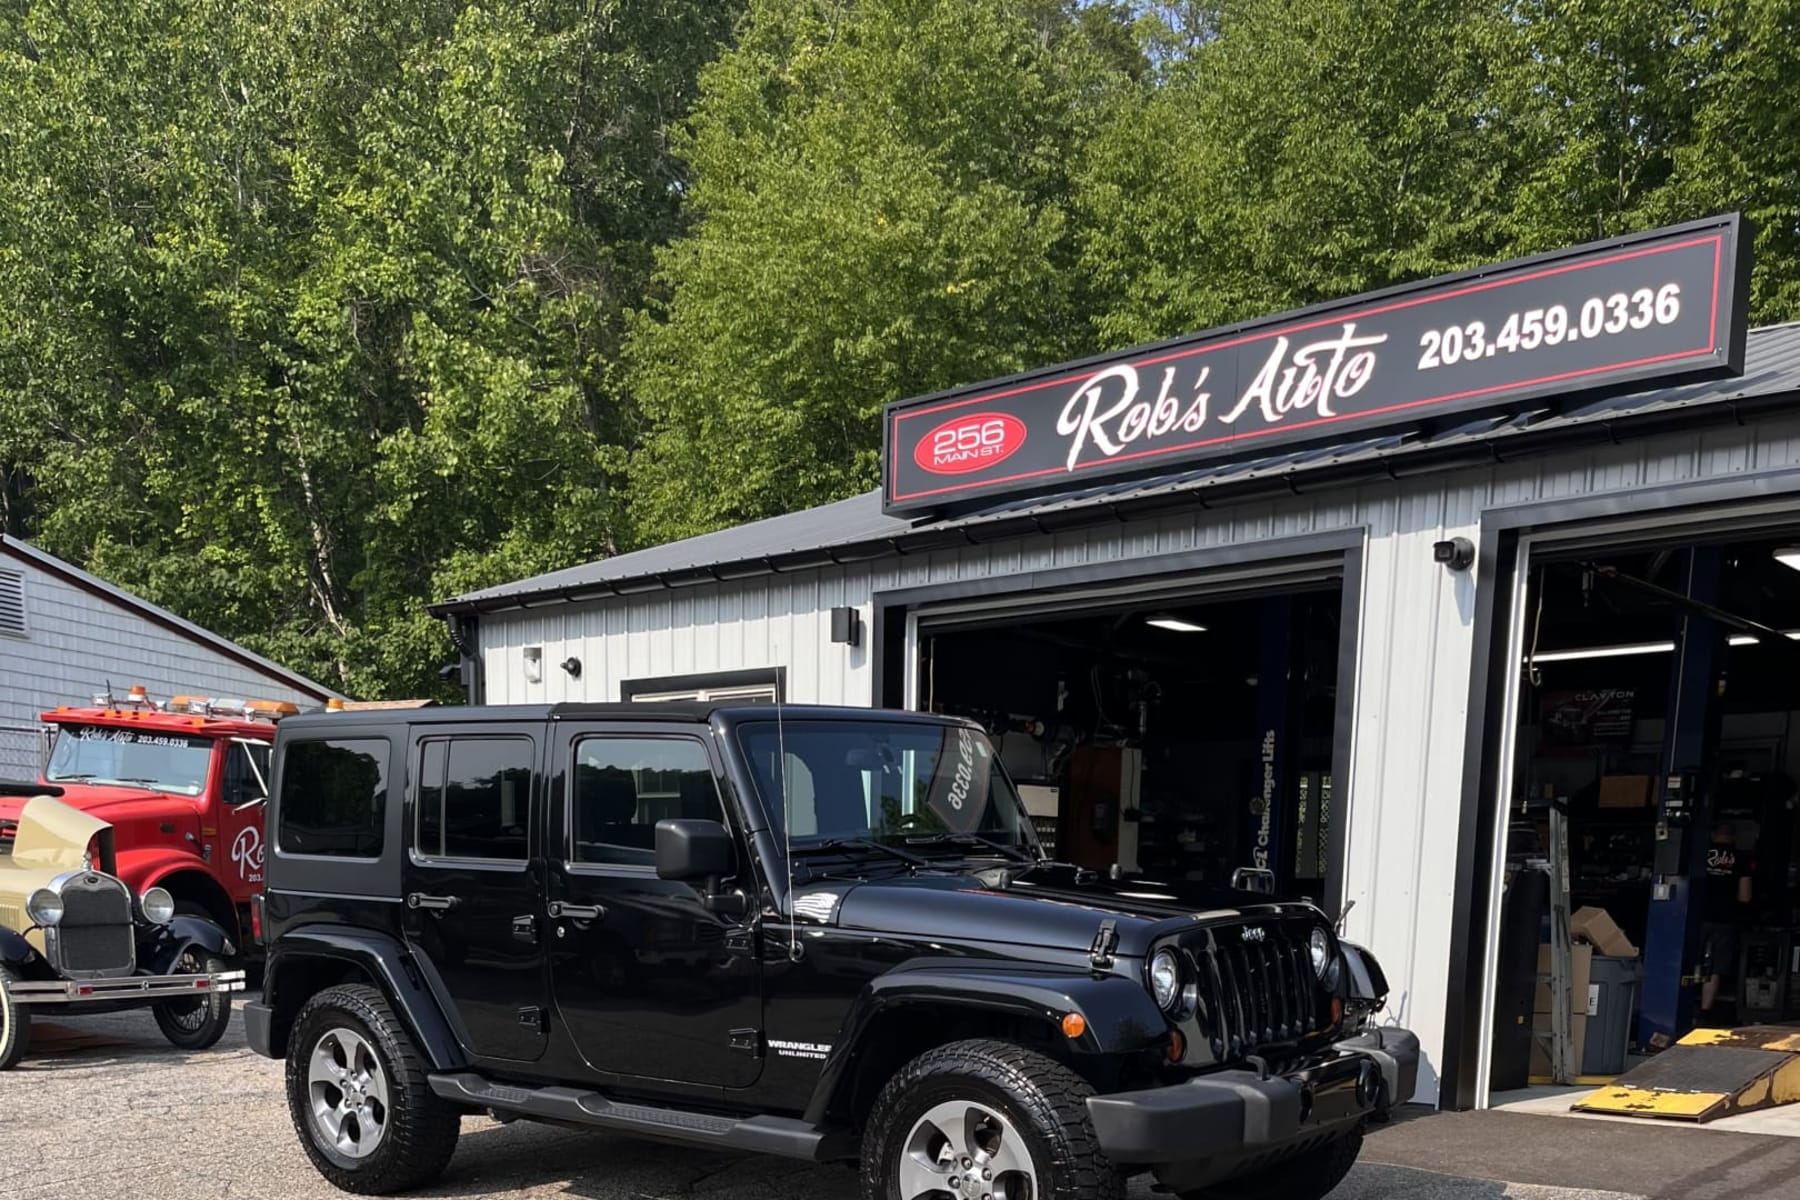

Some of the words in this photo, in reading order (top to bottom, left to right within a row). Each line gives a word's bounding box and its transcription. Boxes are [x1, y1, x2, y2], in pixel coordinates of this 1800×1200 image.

[1417, 283, 1681, 370] 203.459.0336
[1056, 363, 1211, 472] Rob's
[1218, 323, 1388, 424] Auto
[933, 420, 1005, 455] 256
[934, 449, 979, 466] MAIN
[1262, 729, 1276, 762] Lifts
[1241, 925, 1265, 941] Jeep
[767, 1039, 832, 1053] WRANGLER
[778, 1049, 827, 1060] UNLIMITED
